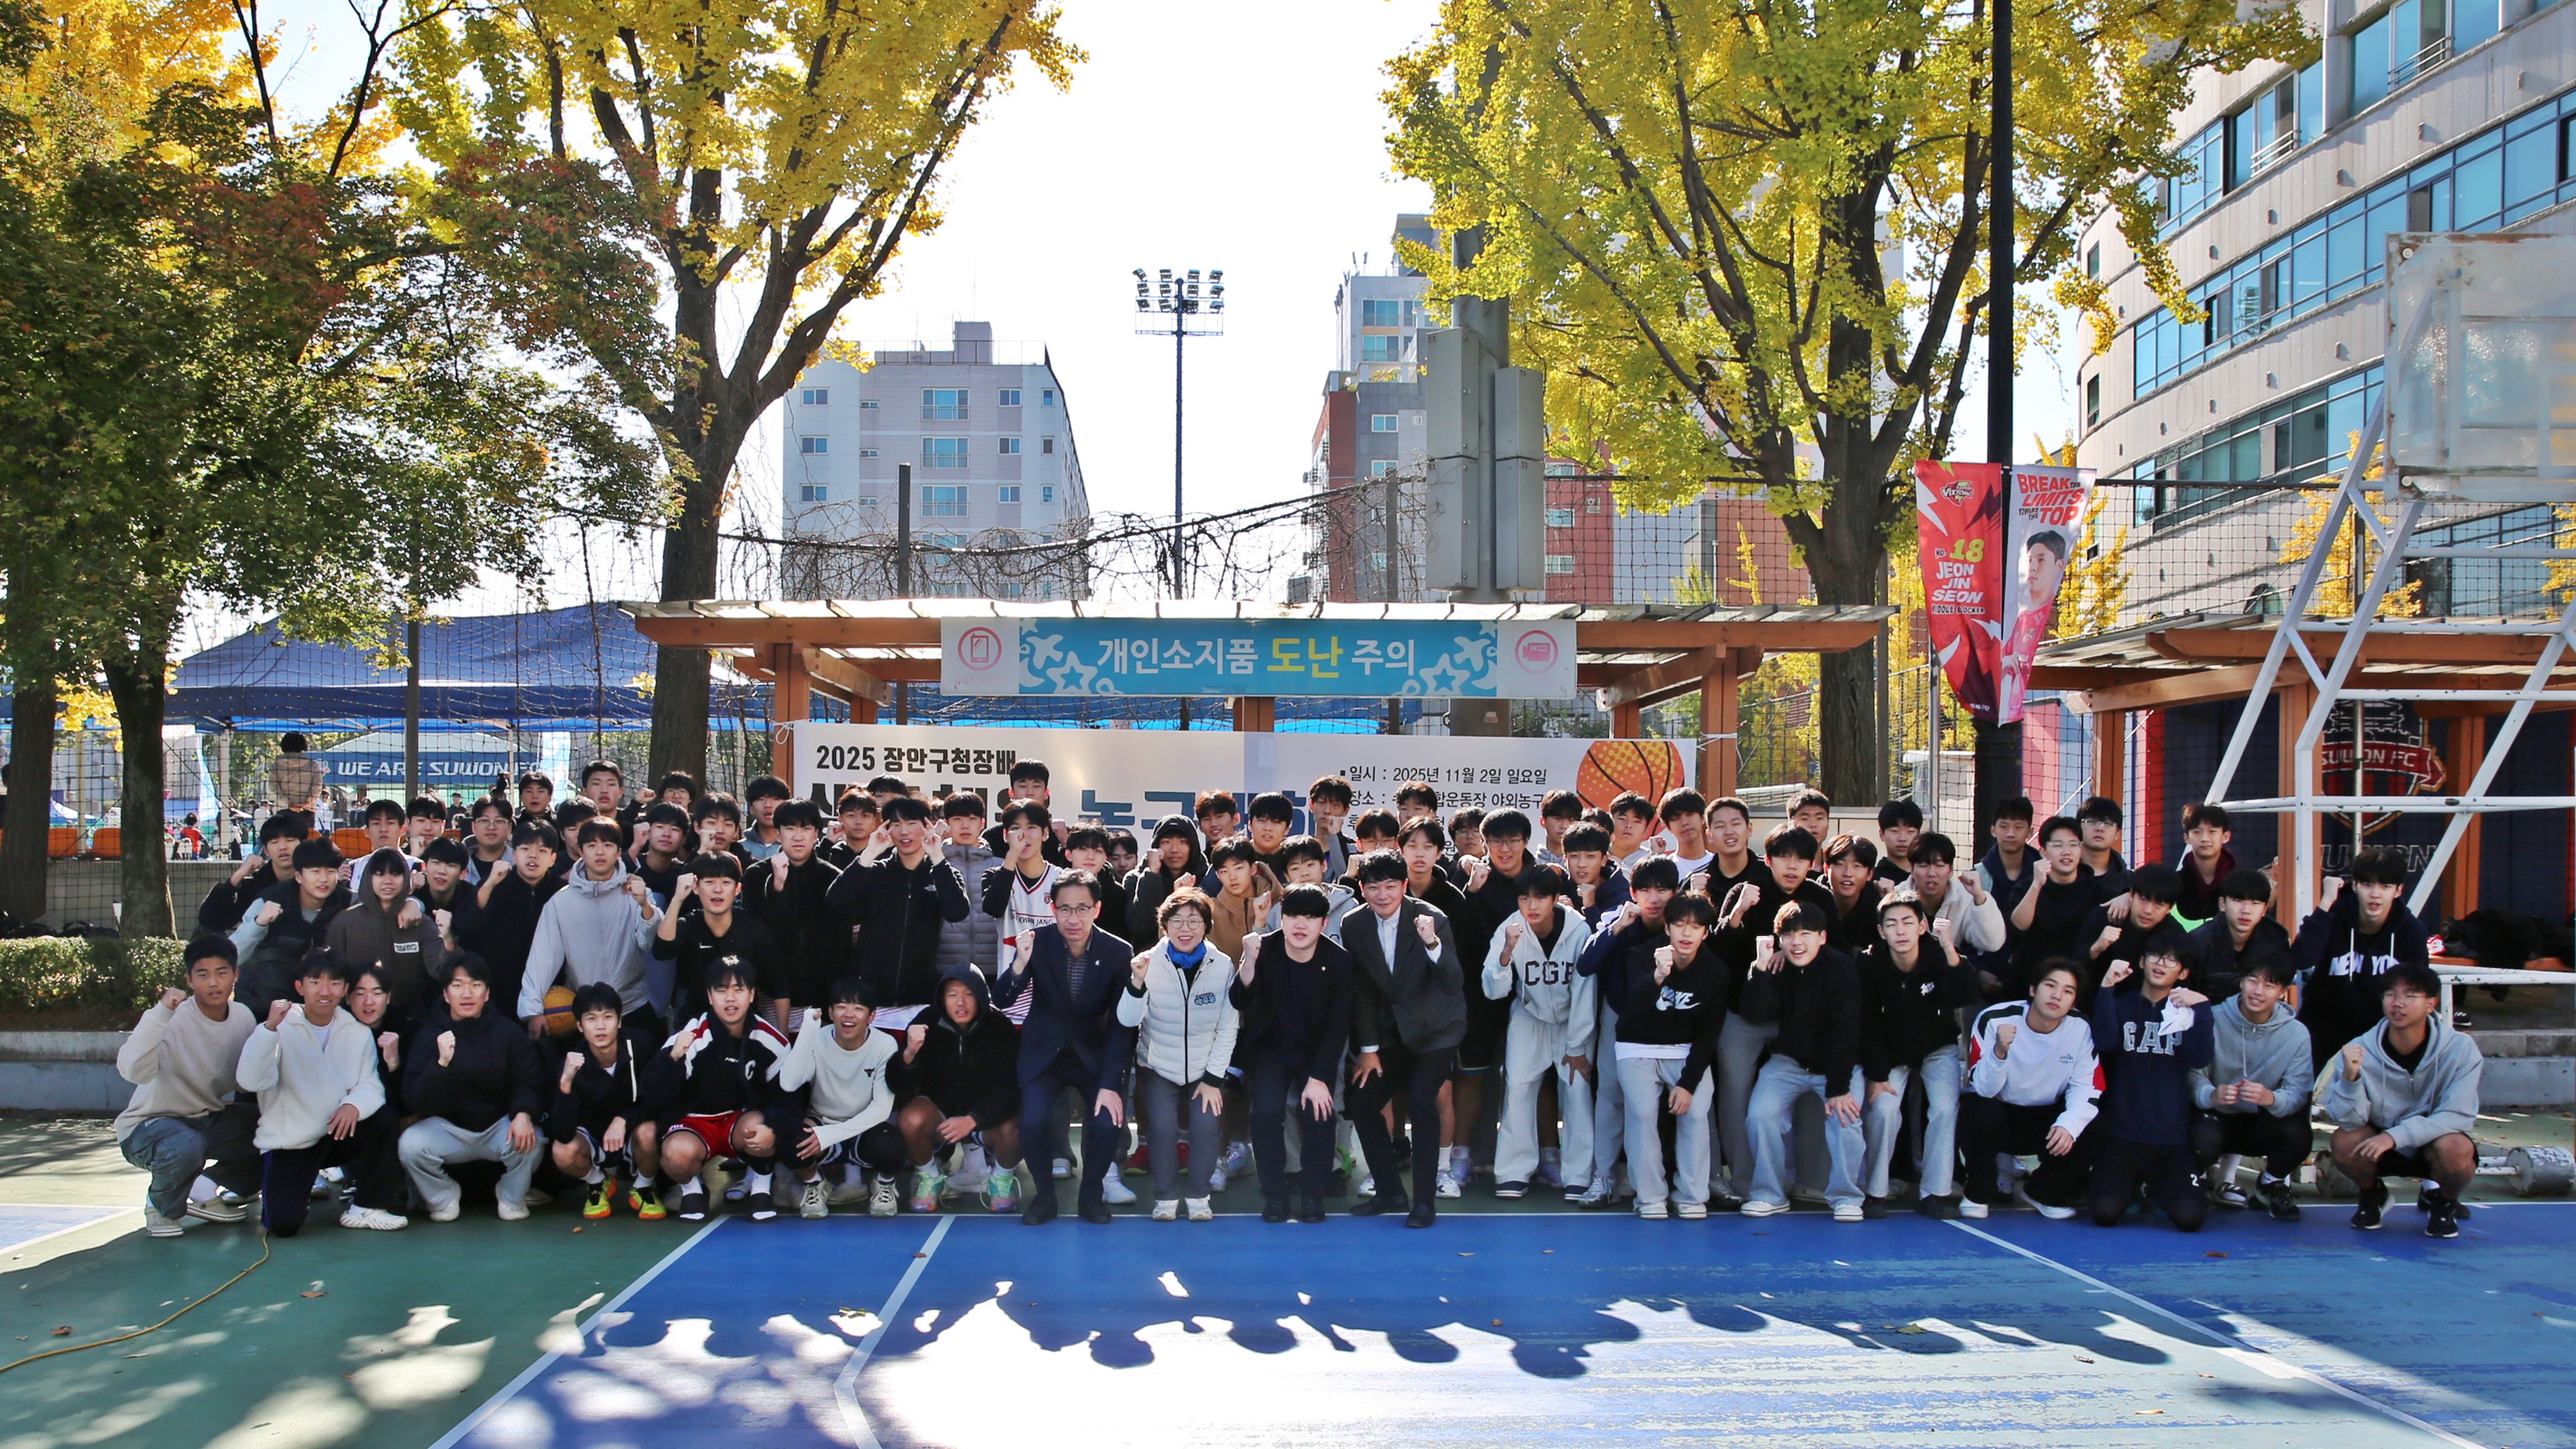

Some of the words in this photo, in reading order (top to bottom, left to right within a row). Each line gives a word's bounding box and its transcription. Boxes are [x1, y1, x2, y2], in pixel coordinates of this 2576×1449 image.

[2017, 474, 2071, 493] BREAK
[2040, 506, 2078, 526] TOP
[1949, 538, 1985, 562] 18
[1936, 561, 1975, 579] JEON
[1942, 578, 1971, 589] JIN
[1932, 589, 1983, 603] SEON
[1097, 637, 1259, 675] 개인소지품
[1267, 636, 1344, 678] 도난
[1352, 640, 1415, 676] 주의
[816, 745, 875, 770] 2025
[883, 747, 1016, 775] 장안구청장배
[2390, 751, 2418, 767] FC
[338, 762, 373, 776] WE
[1349, 766, 1376, 781] 일시
[1393, 767, 1439, 782] 2025년
[1446, 768, 1474, 783] 11월
[1480, 769, 1501, 784] 2일
[1507, 770, 1547, 785] 일요일
[2329, 951, 2364, 976] NEW
[2123, 1021, 2182, 1055] GAP
